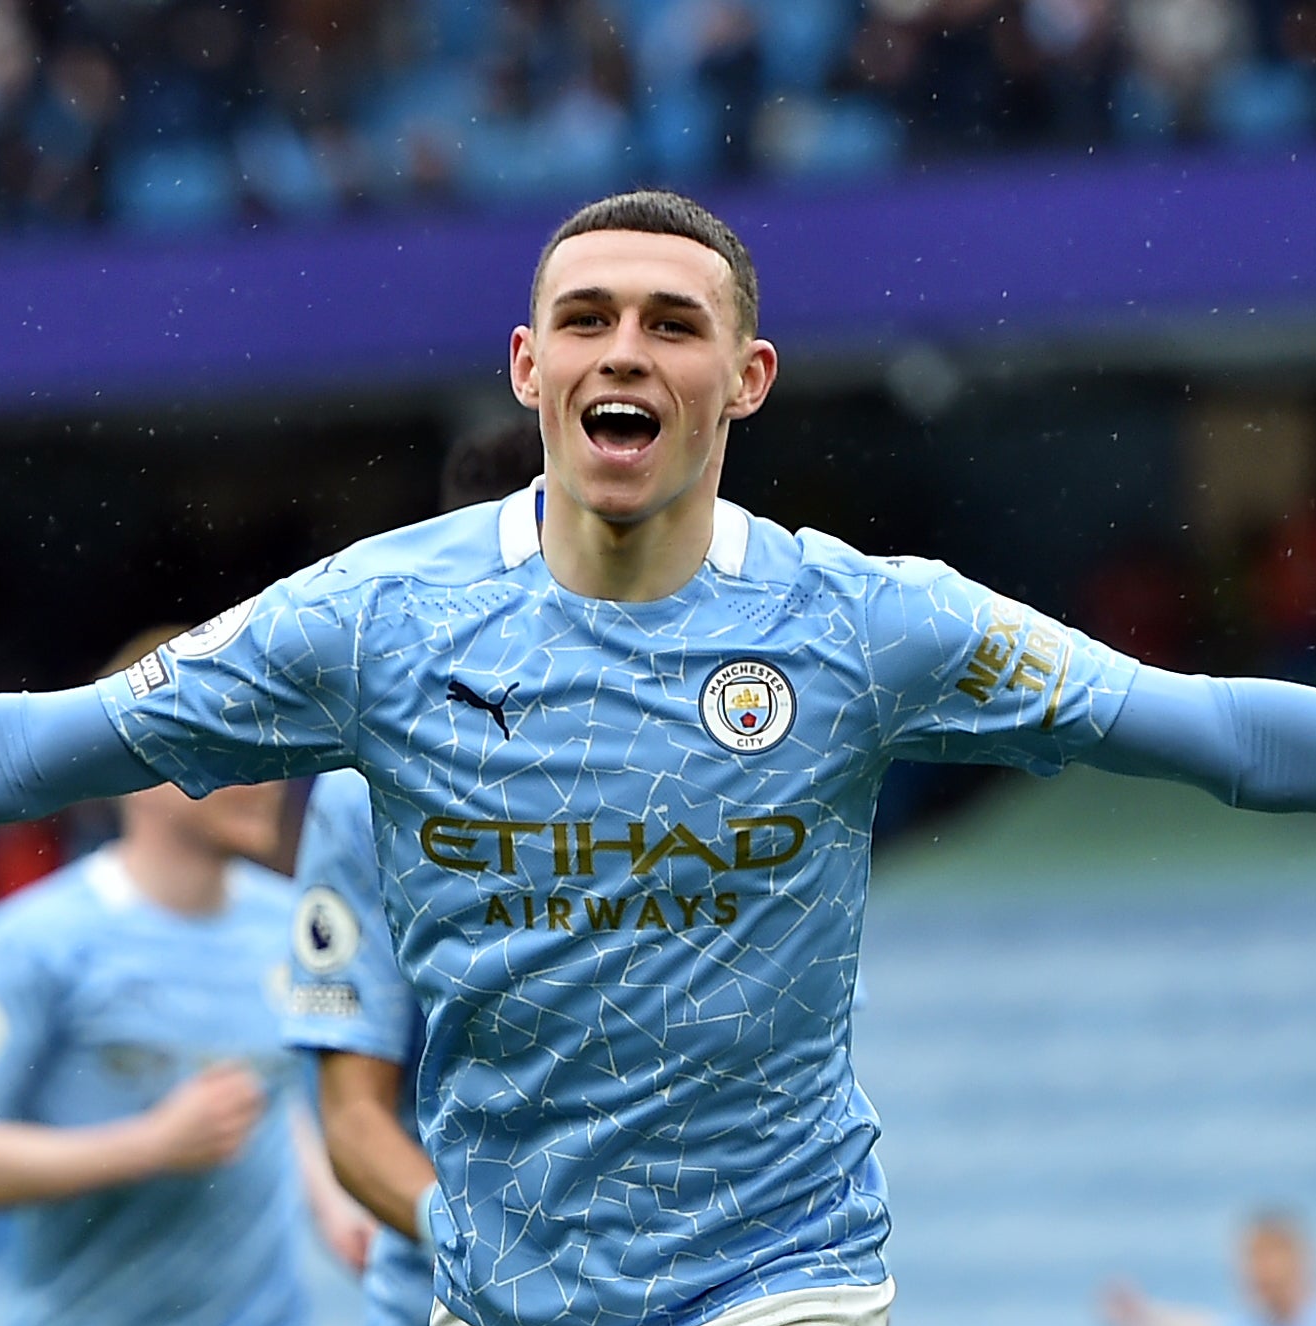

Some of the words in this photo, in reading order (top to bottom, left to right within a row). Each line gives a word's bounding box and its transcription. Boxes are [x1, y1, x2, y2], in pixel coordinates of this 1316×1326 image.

[709, 664, 784, 695] MANCHESTER
[736, 738, 764, 747] CITY
[420, 814, 807, 877] ETIHAD
[484, 892, 739, 931] AIRWAYS
